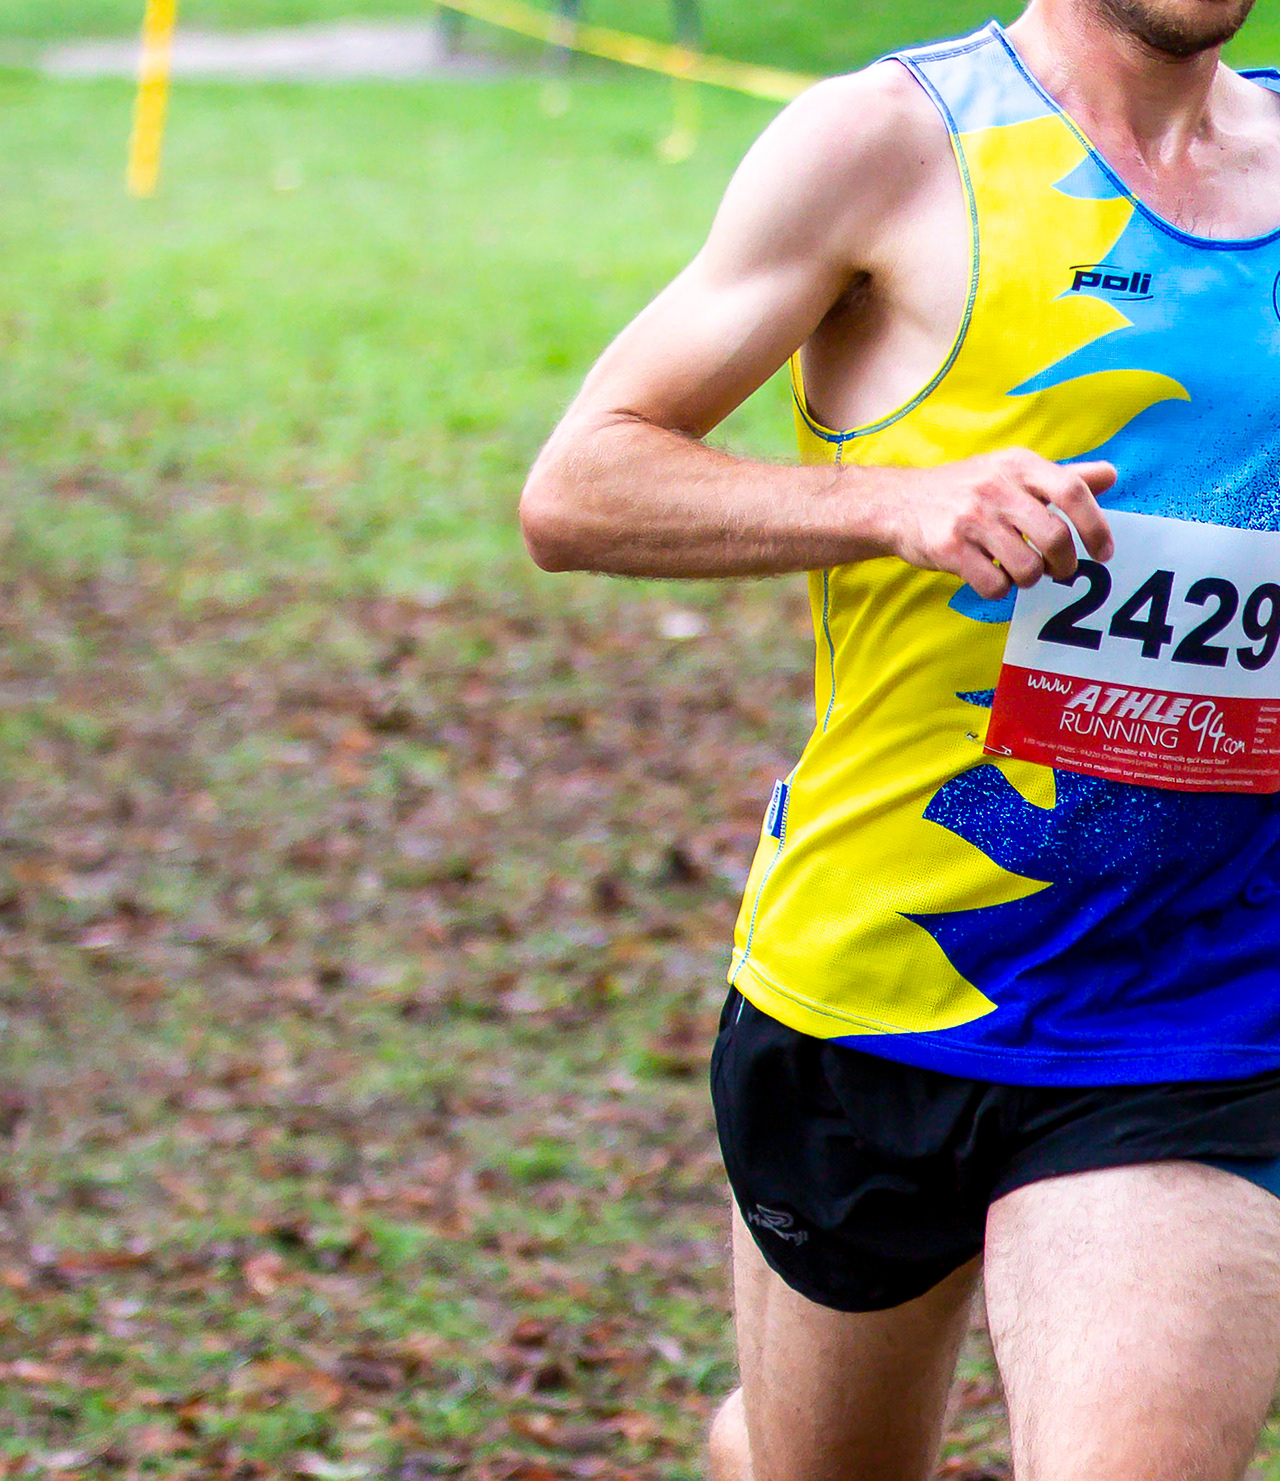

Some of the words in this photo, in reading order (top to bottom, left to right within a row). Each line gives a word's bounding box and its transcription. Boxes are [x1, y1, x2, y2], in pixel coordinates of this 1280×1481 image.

[1071, 270, 1152, 294] poli
[1064, 685, 1193, 726] ATHLE
[1059, 712, 1179, 748] RUNNING
